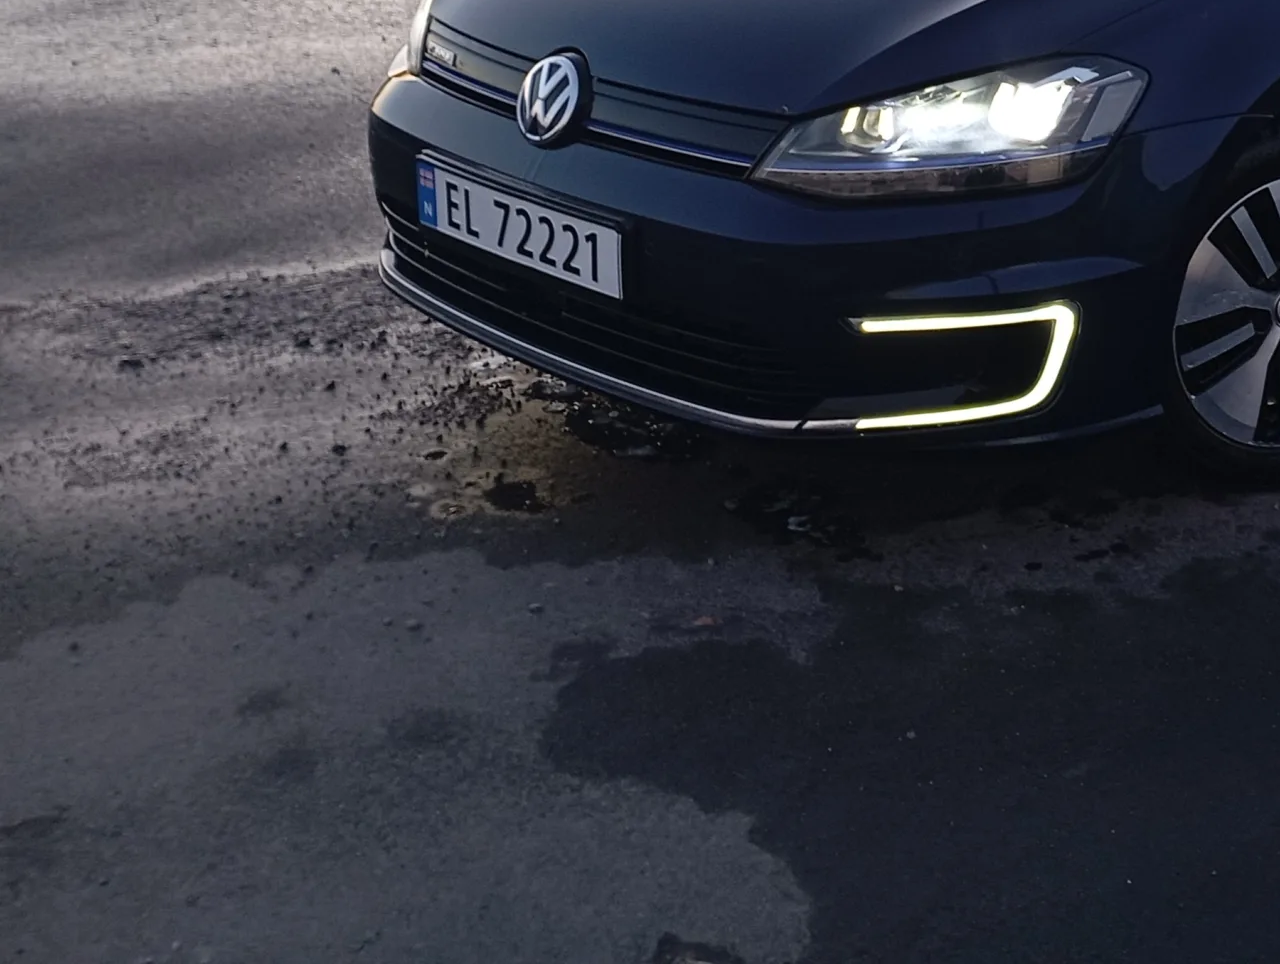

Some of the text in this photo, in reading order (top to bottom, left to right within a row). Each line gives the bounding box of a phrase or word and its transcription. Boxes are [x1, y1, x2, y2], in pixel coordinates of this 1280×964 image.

[519, 55, 578, 140] VW
[423, 200, 433, 217] N
[445, 181, 599, 283] EL 72221
